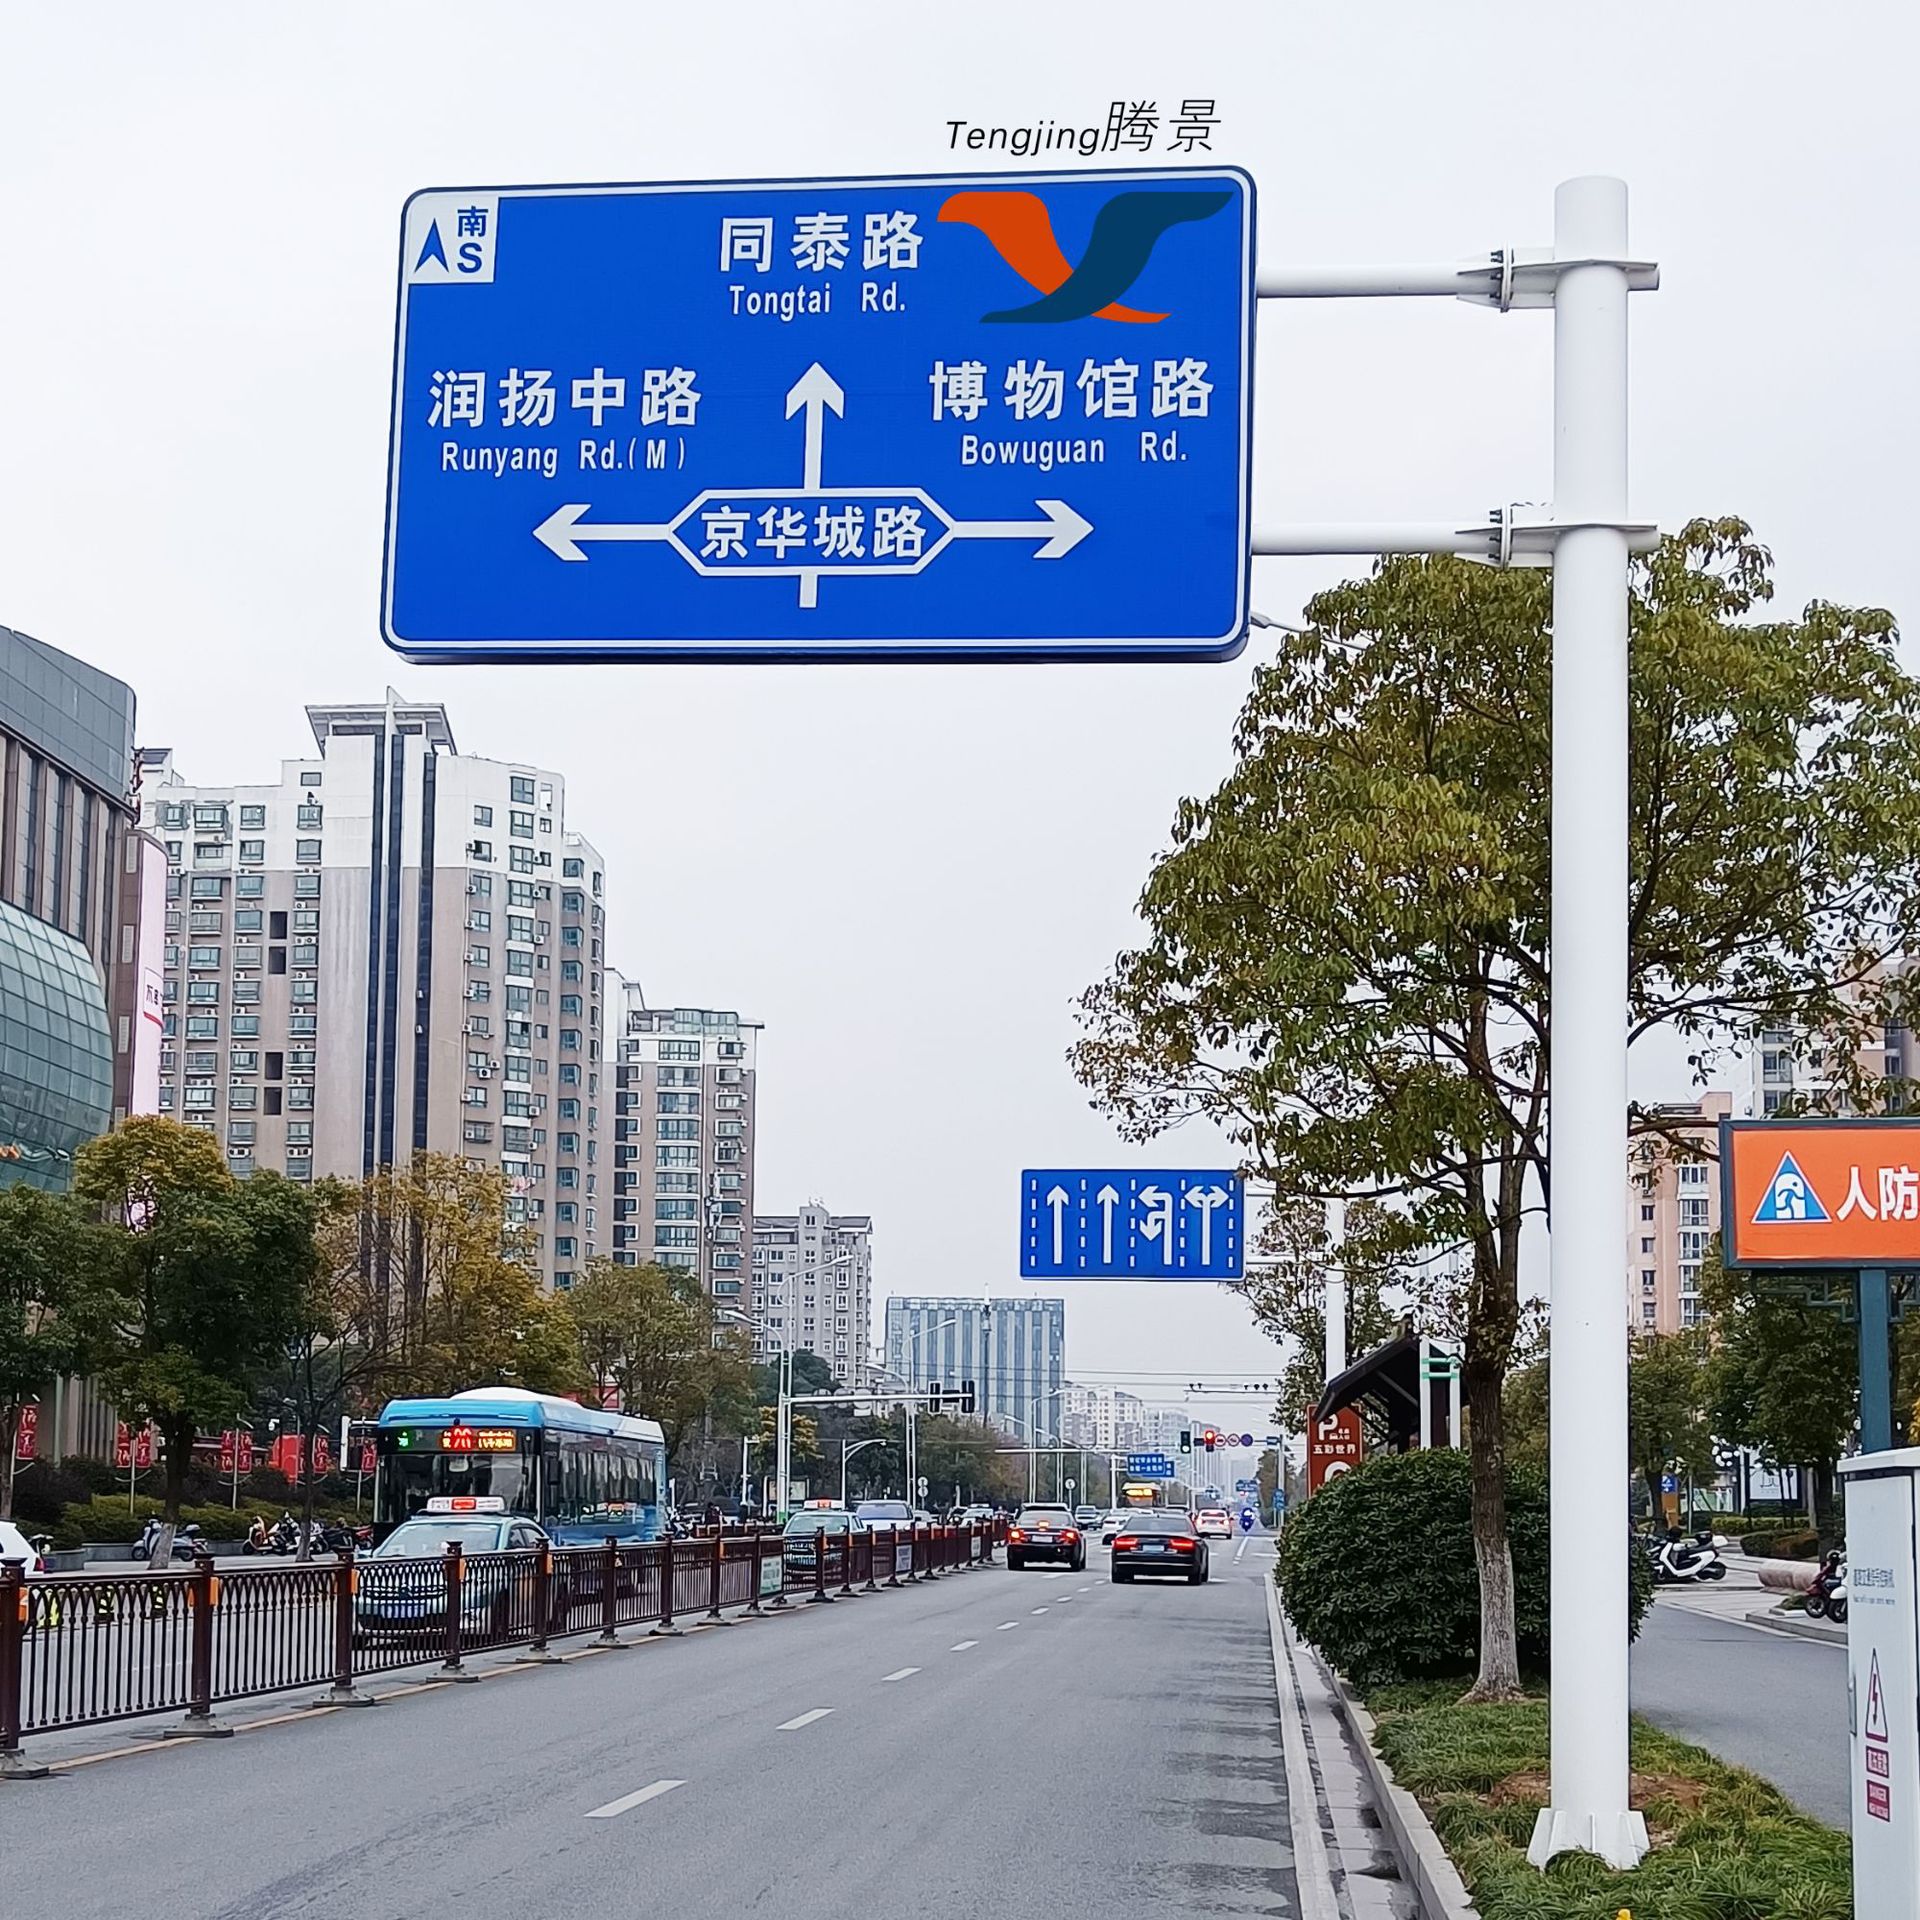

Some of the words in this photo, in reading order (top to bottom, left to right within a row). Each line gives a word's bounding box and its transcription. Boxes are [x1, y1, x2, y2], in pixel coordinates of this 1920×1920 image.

[457, 205, 489, 238] 南
[719, 209, 924, 274] 同泰路
[456, 243, 484, 274] S
[729, 282, 831, 322] Tongtai
[861, 280, 907, 312] Rd.
[427, 366, 702, 429] 润扬中路
[928, 356, 1215, 422] 博物馆路
[441, 440, 559, 478] Runyang
[961, 434, 1105, 472] Bowuguan
[1140, 430, 1188, 463] Rd.
[699, 503, 928, 561] 京华城路
[1312, 1443, 1357, 1455] 五彩世界
